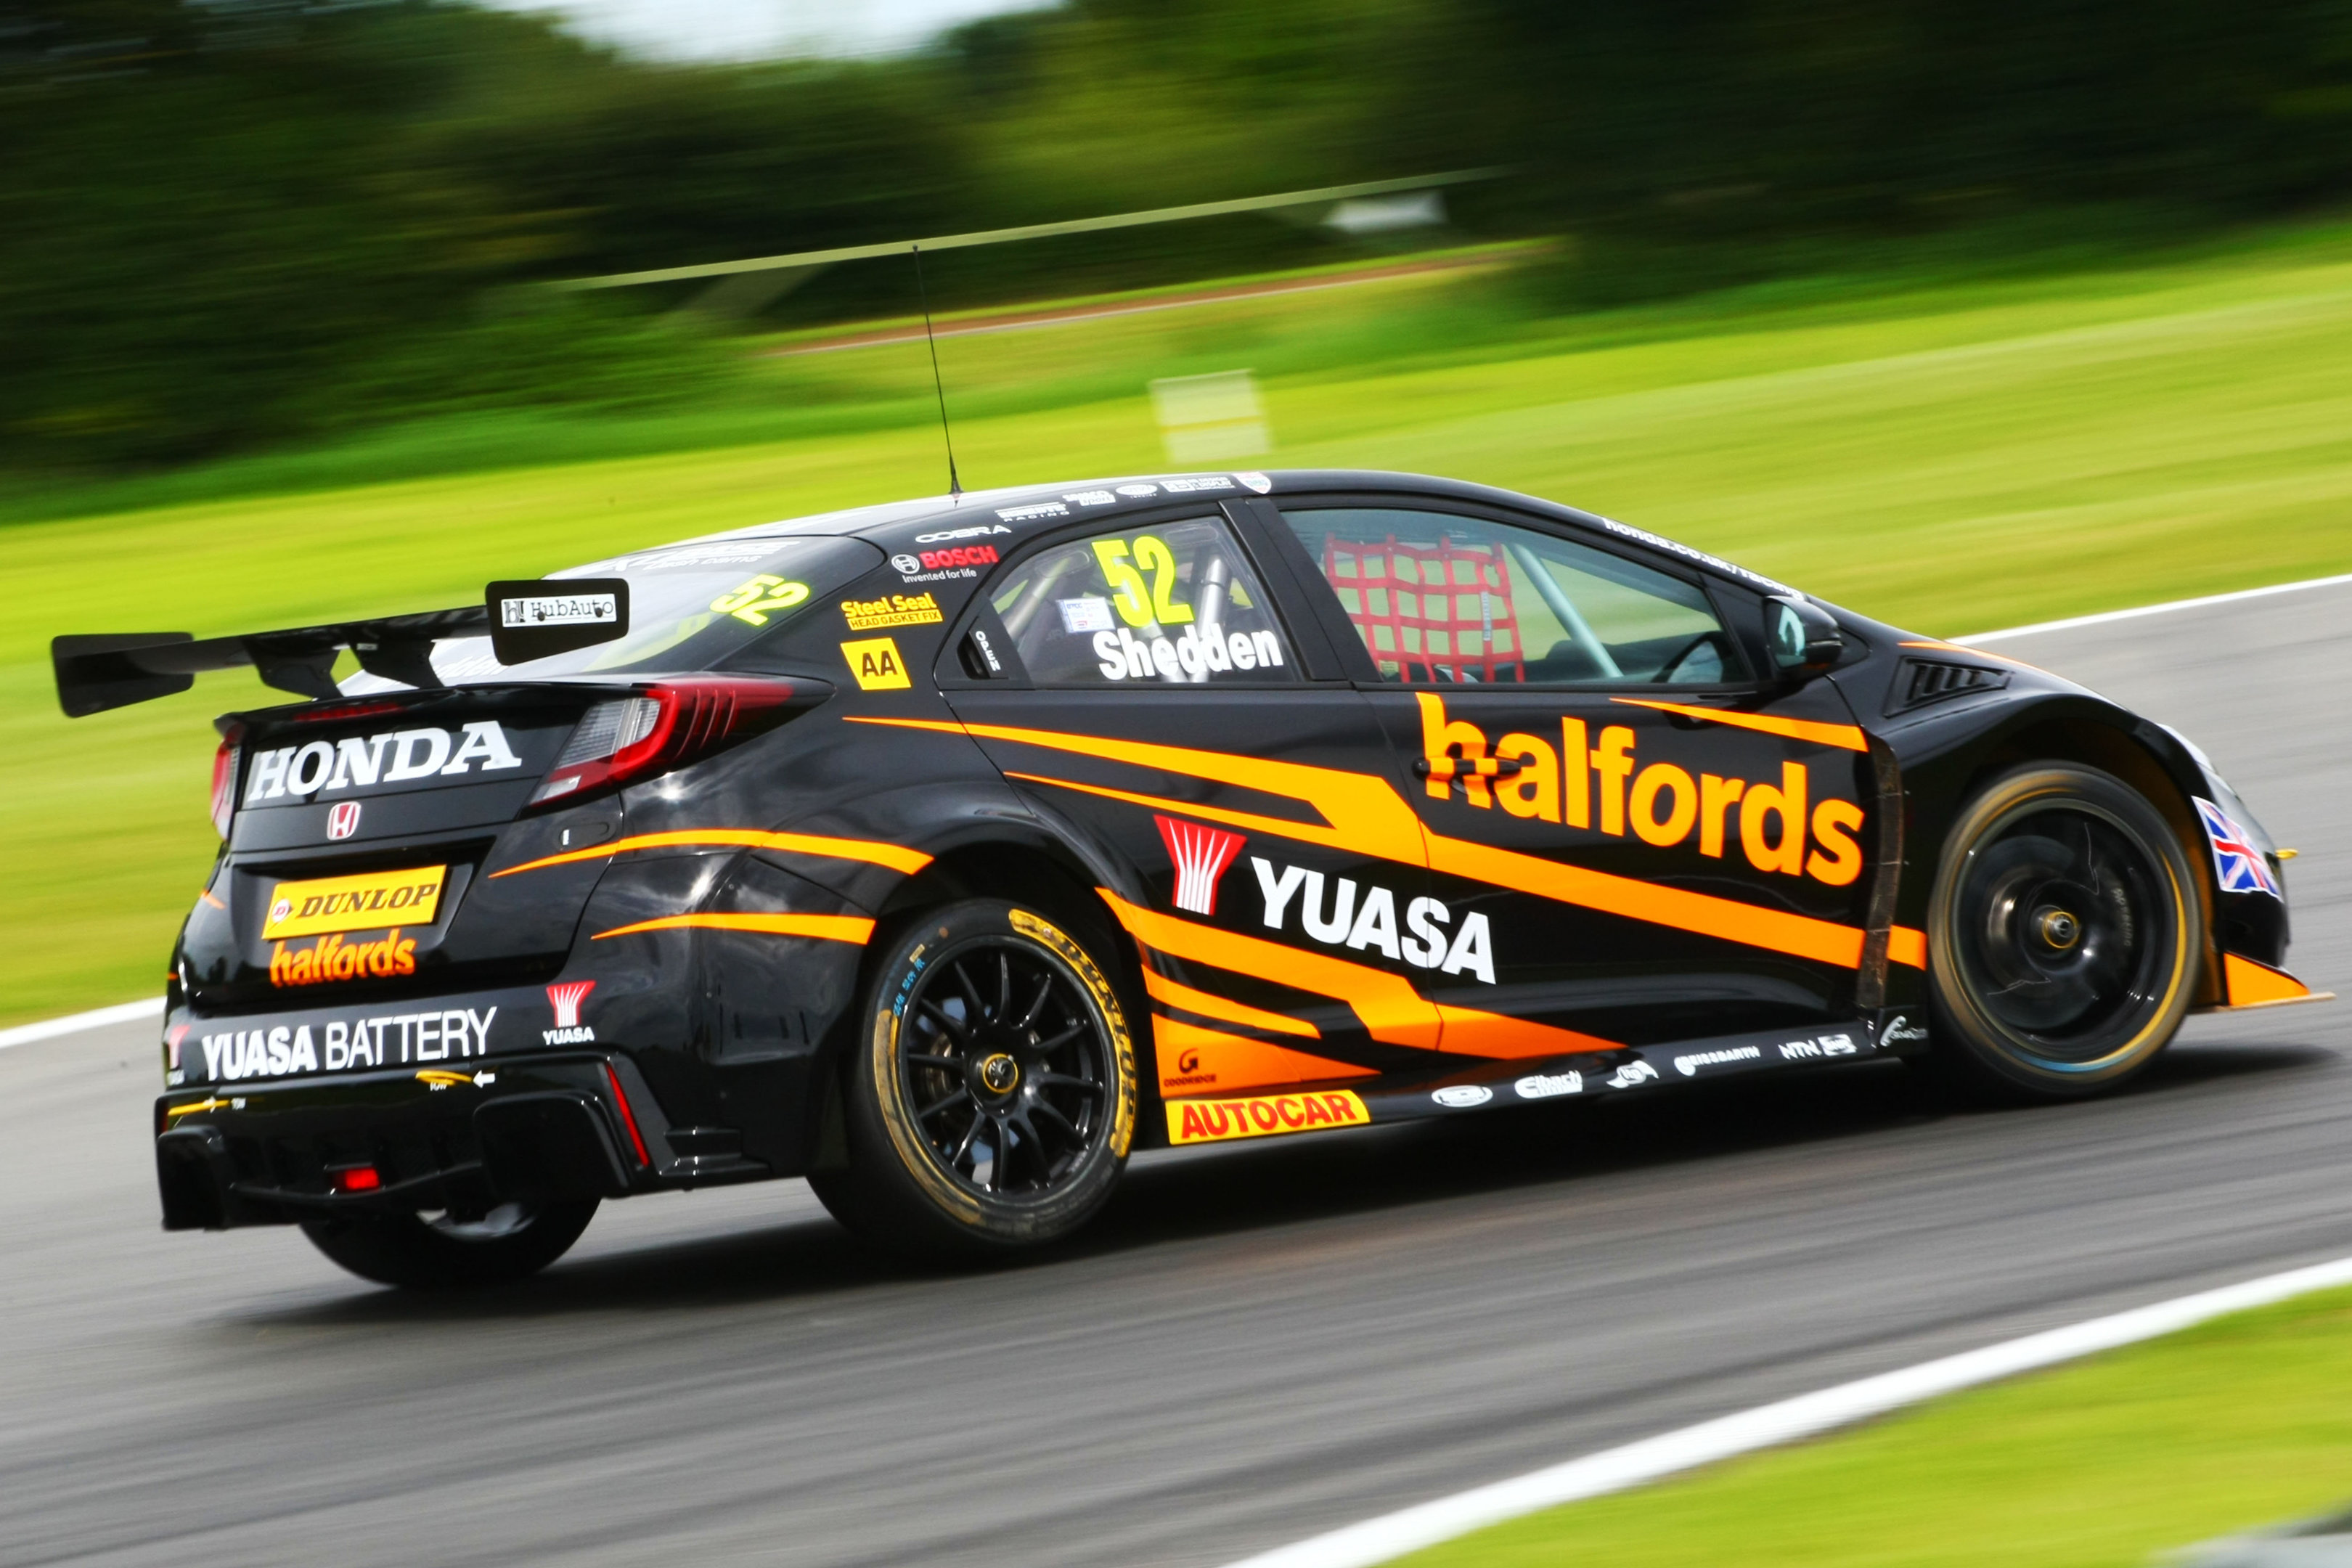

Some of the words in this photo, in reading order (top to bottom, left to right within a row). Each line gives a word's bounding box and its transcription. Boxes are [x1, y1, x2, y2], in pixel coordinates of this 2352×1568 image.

[915, 525, 1012, 543] COBRA
[902, 570, 946, 583] Invented
[946, 569, 961, 579] for
[961, 568, 977, 578] life
[919, 545, 1000, 569] BOSCH
[709, 573, 812, 626] 52
[1092, 536, 1195, 627] 52
[531, 599, 614, 618] HubAuto
[841, 597, 894, 617] Steel
[892, 592, 937, 612] Seal
[850, 618, 880, 629] HEAD
[881, 614, 921, 624] GASKET
[921, 611, 941, 621] FIX
[862, 650, 899, 677] AA
[976, 631, 1001, 671] OPEN
[1093, 623, 1283, 680] Shedden
[247, 720, 521, 801] HONDA
[1415, 692, 1866, 887] halfords
[295, 883, 438, 920] DUNLOP
[1250, 856, 1497, 984] YUASA
[269, 928, 417, 987] halfords
[202, 1024, 317, 1082] YUASA
[325, 1006, 498, 1071] BATTERY
[543, 1026, 595, 1045] YUASA
[1779, 1040, 1823, 1060] NTN
[1181, 1094, 1359, 1140] AUTOCAR
